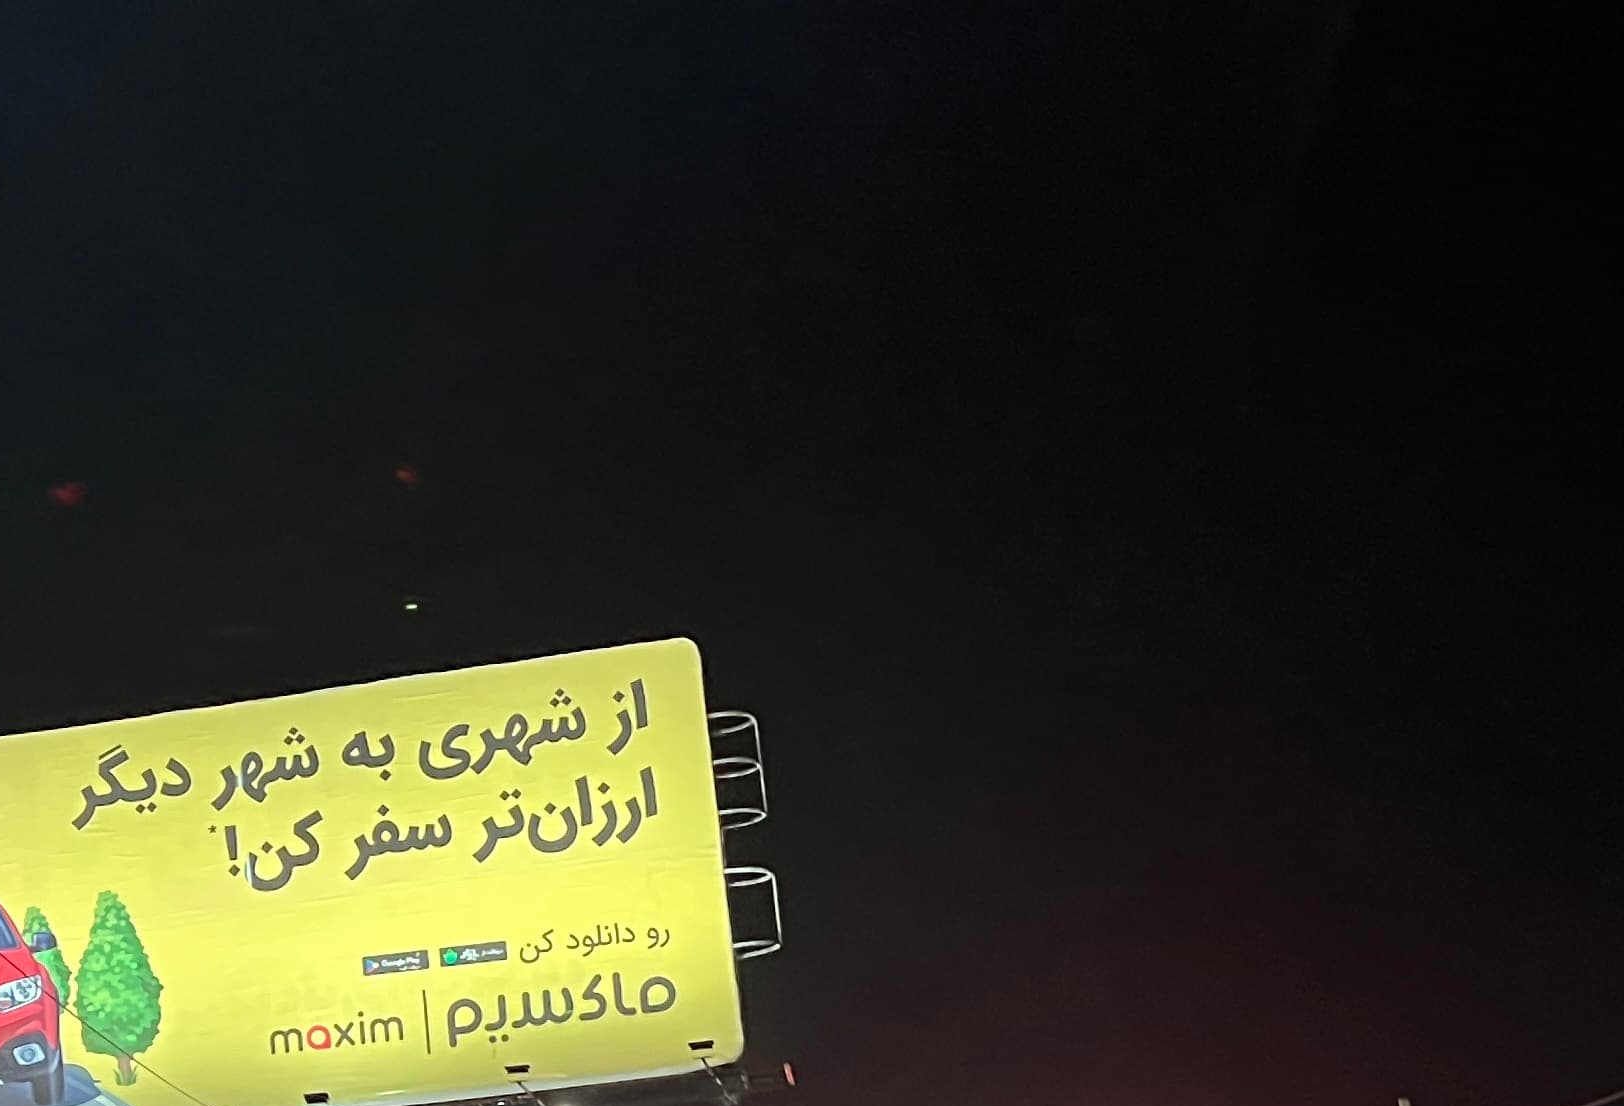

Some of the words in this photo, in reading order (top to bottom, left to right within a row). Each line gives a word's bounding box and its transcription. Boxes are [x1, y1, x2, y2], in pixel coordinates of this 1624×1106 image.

[418, 688, 587, 780] شهری
[606, 678, 649, 756] از
[71, 744, 192, 831] دیگر
[210, 726, 320, 812] شهر
[341, 730, 396, 781] به
[344, 804, 453, 880] سفر
[518, 929, 555, 964] کن
[565, 922, 637, 958] دانلود
[646, 926, 671, 949] رو
[269, 1010, 405, 1056] maxim
[445, 971, 678, 1048] ماکسیم
